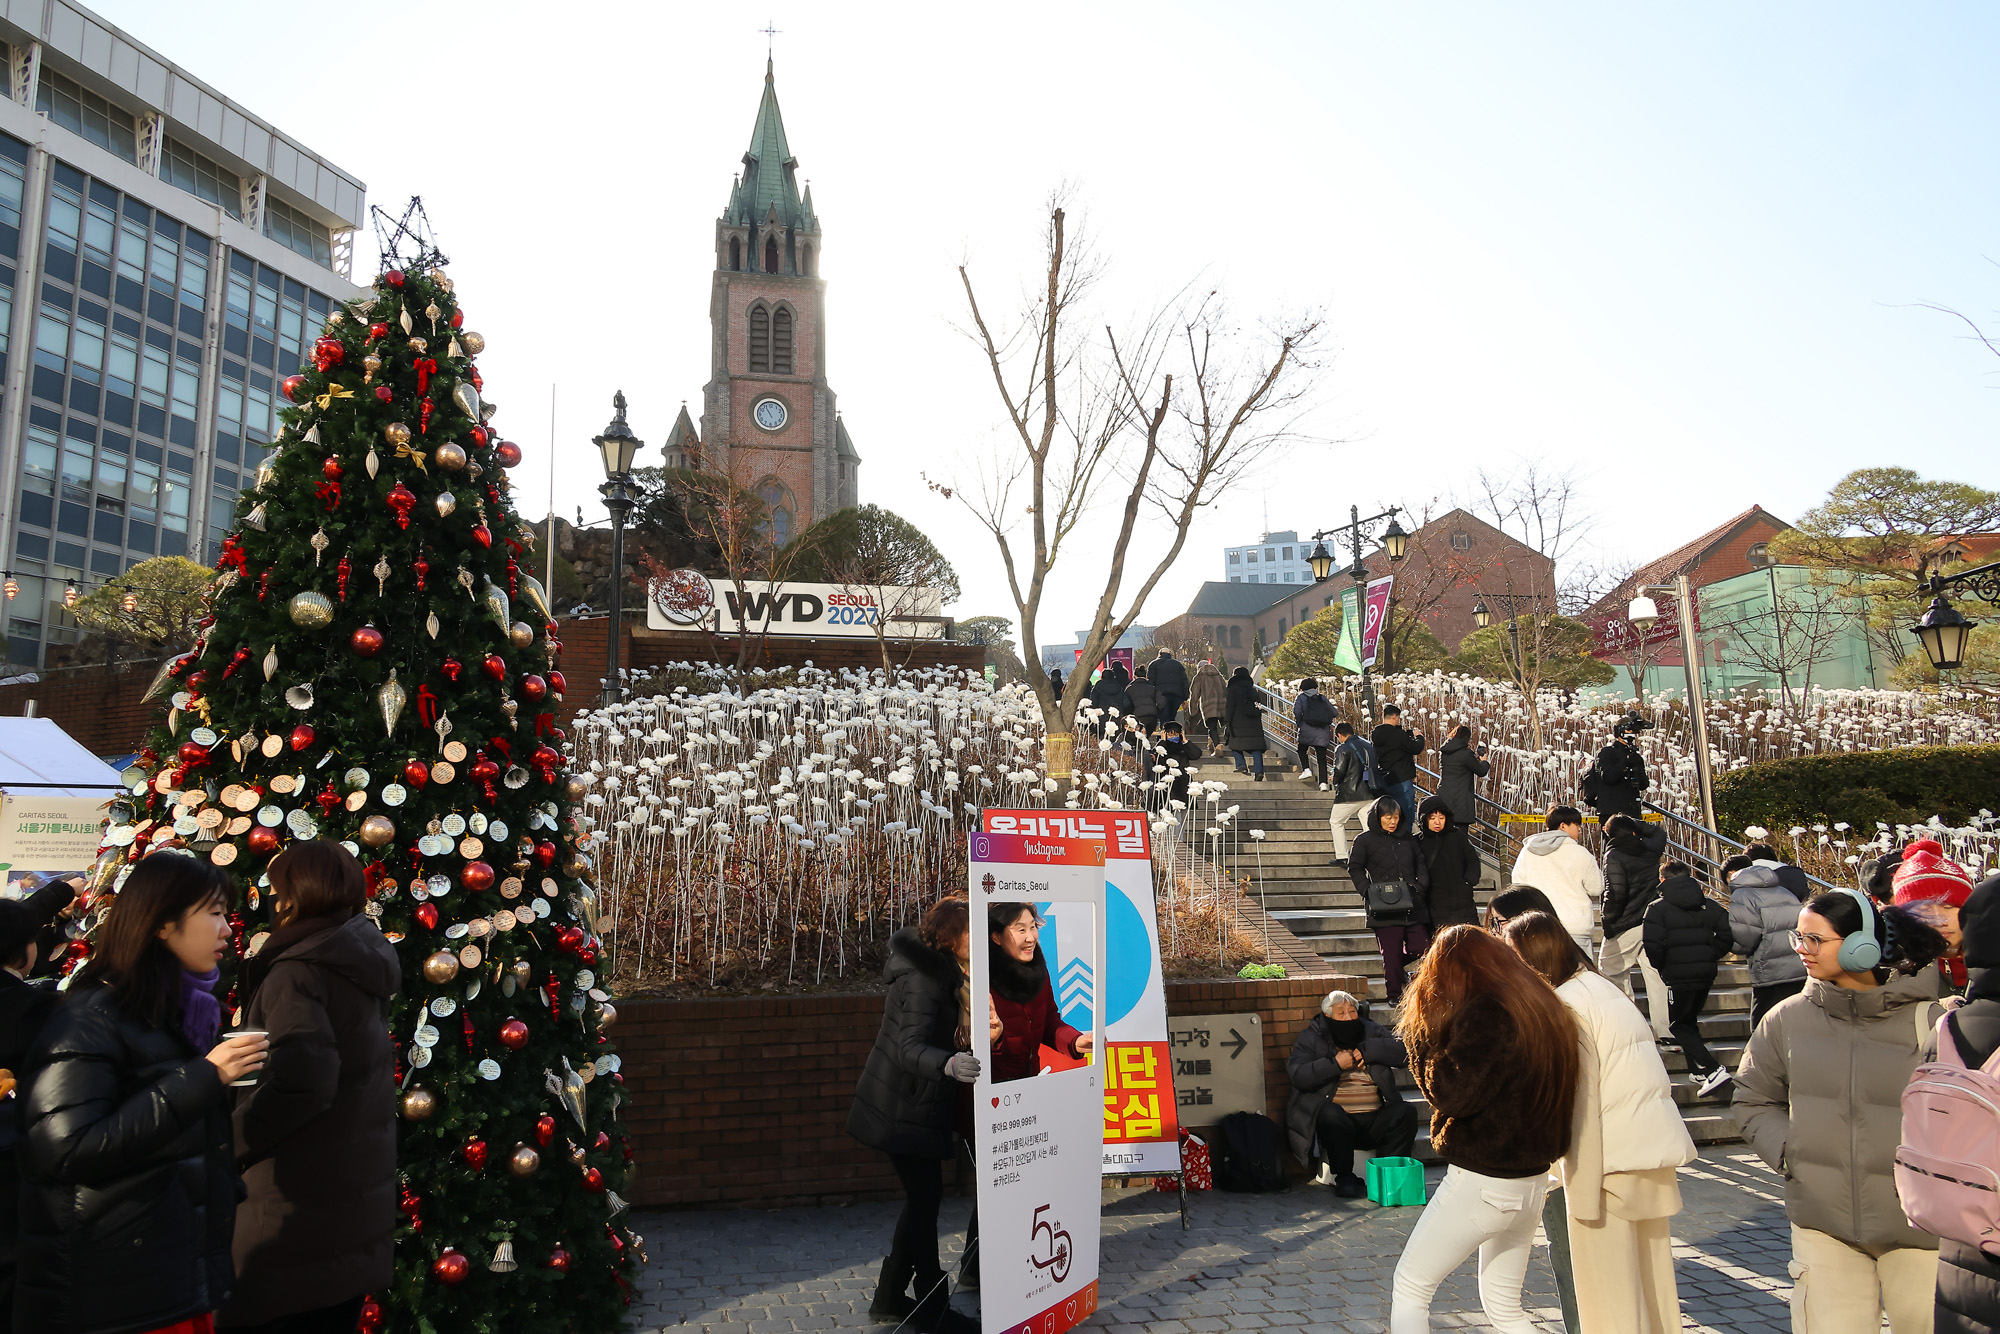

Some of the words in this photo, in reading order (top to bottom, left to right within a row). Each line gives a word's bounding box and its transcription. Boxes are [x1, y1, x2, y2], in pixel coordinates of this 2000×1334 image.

[725, 591, 824, 622] WYD
[827, 594, 878, 607] SEOUL
[827, 606, 878, 625] 2027
[47, 812, 69, 820] SEOUL
[1115, 819, 1145, 853] 길
[1024, 839, 1067, 862] Instagram
[998, 880, 1049, 892] Caritas_Seoul
[992, 1122, 1007, 1133] 좋아요
[993, 1156, 1014, 1170] #모두가
[1015, 1151, 1036, 1166] 인간답게
[1038, 1148, 1047, 1158] 사는
[1048, 1144, 1058, 1156] 세상
[1103, 1153, 1144, 1165] 울대교구
[993, 1171, 1020, 1187] #카리타스
